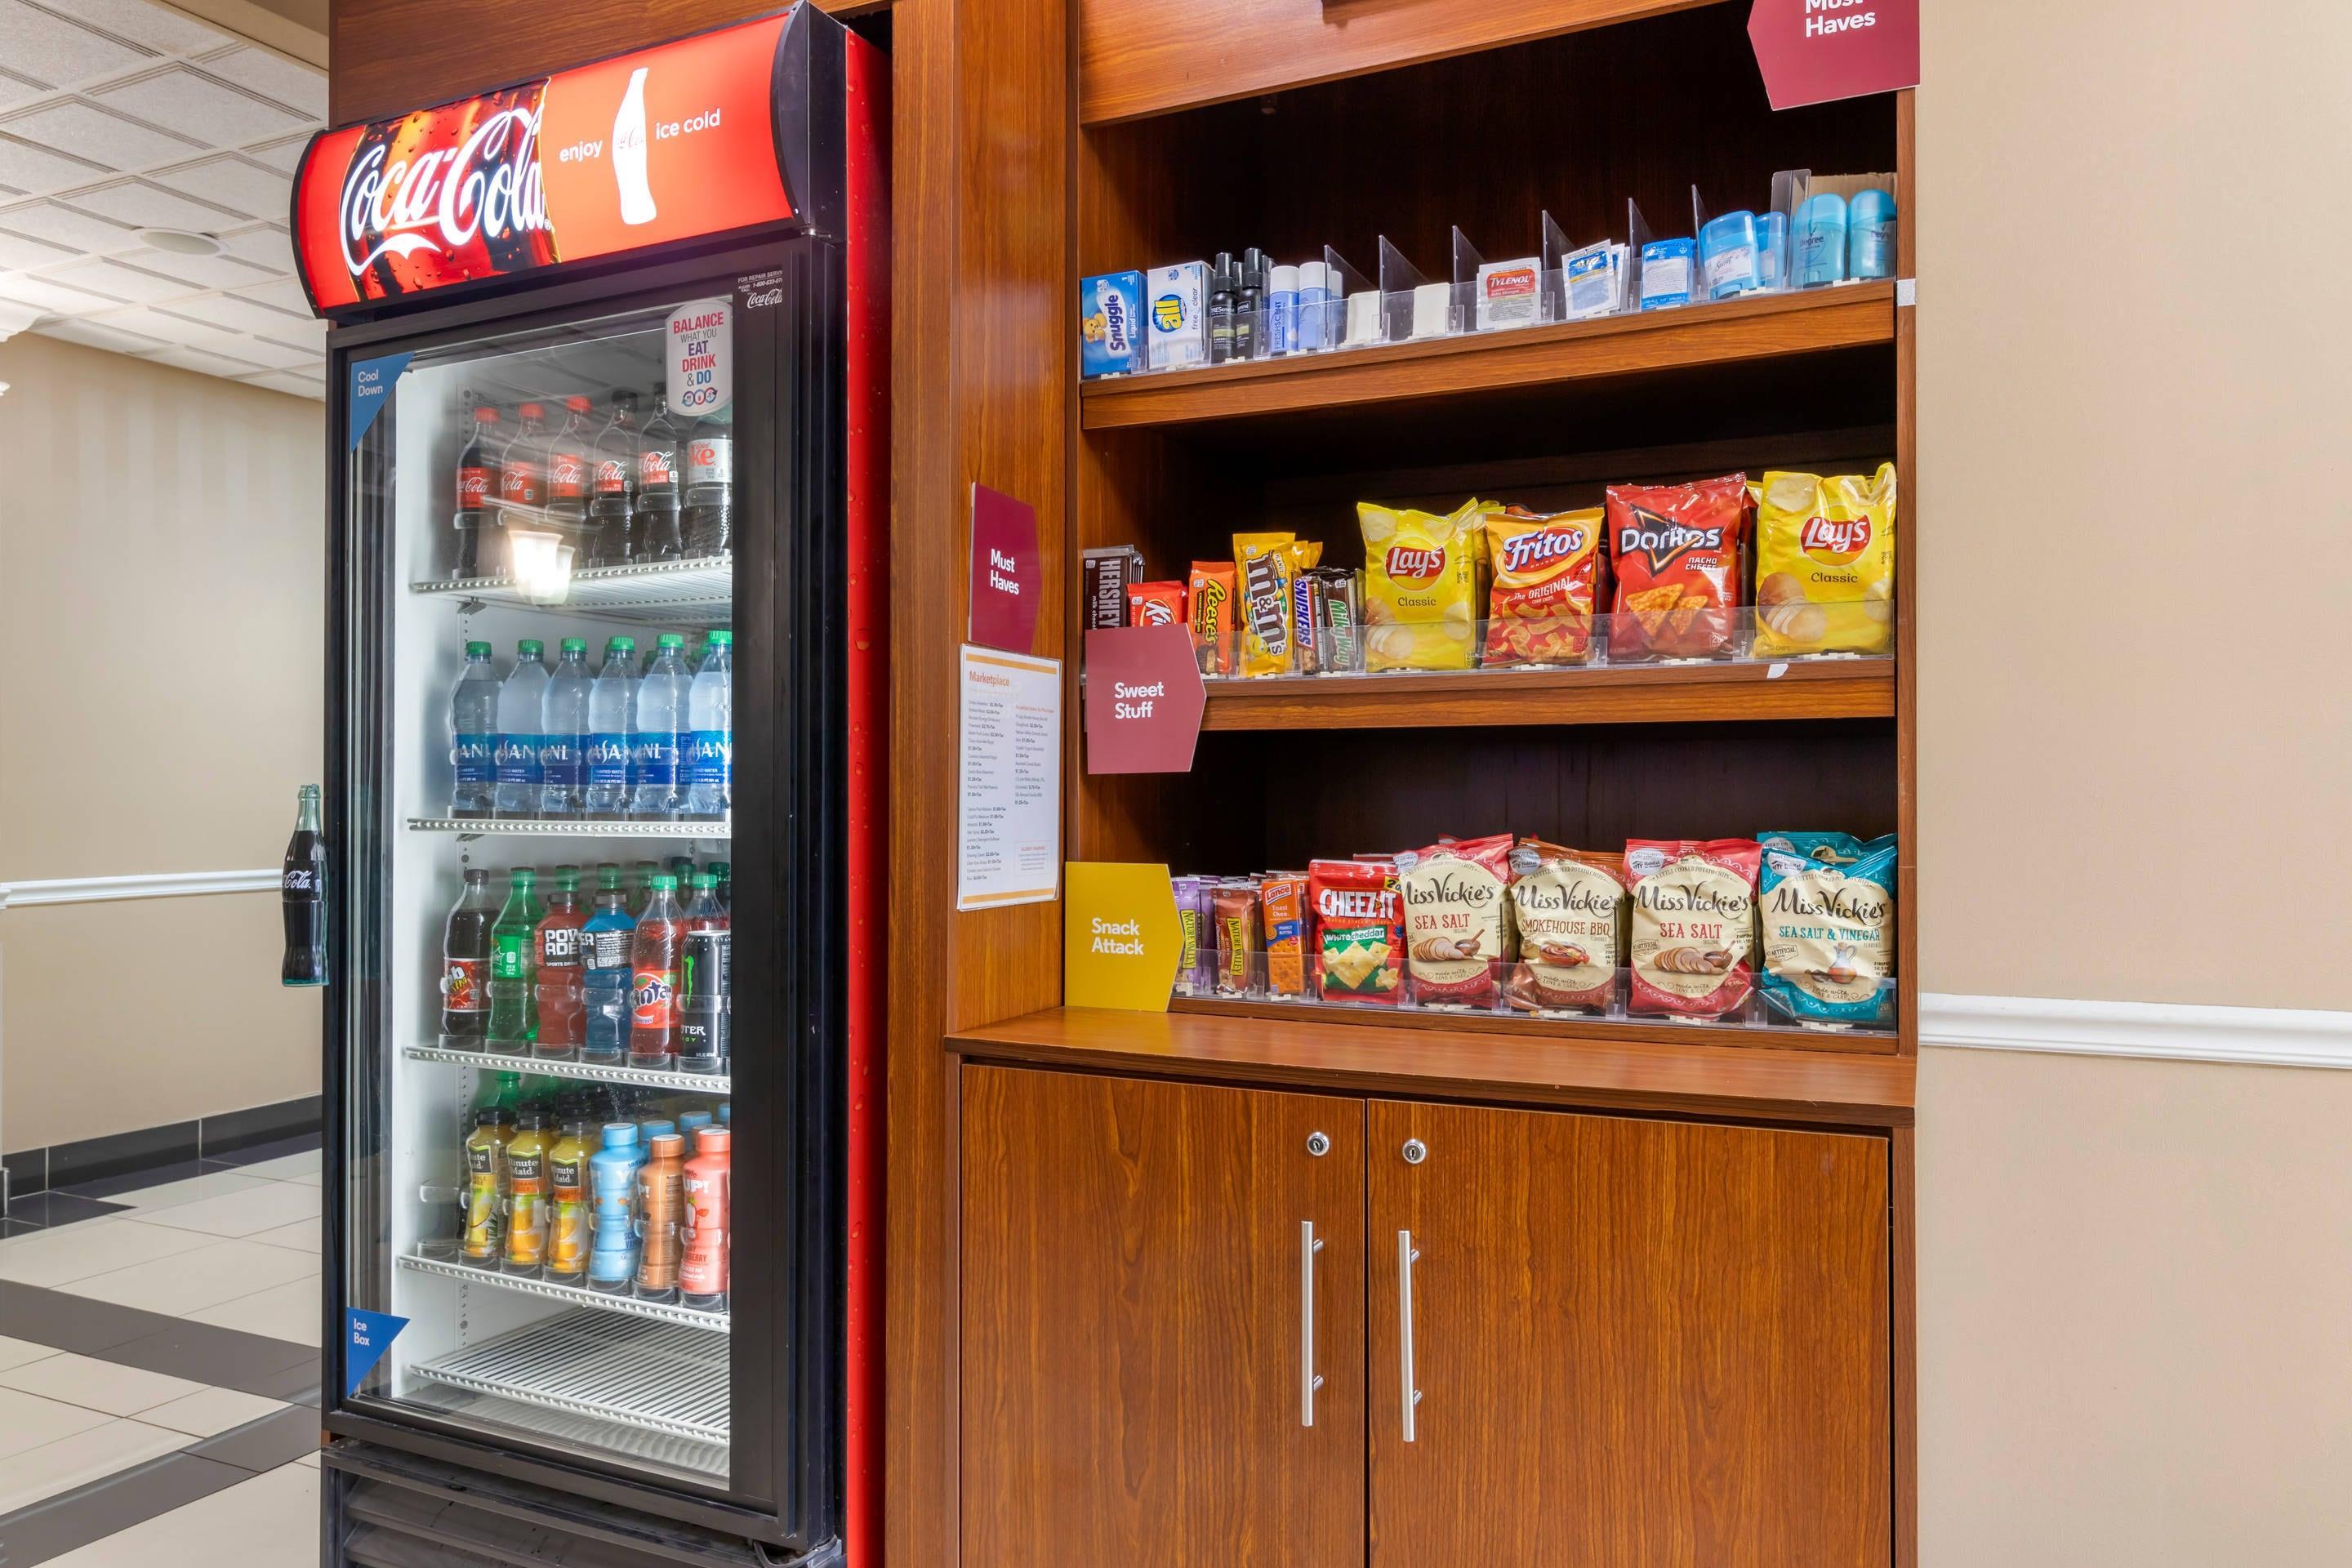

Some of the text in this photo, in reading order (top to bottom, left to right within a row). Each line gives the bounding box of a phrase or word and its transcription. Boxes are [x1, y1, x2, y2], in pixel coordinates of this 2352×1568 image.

[1806, 11, 1876, 38] Haves
[559, 138, 603, 163] enjoy
[656, 121, 679, 140] ice
[683, 108, 721, 131] cold
[340, 105, 550, 276] Coca-Cola
[1490, 275, 1530, 287] TYLENOL
[673, 312, 724, 334] BALANCE
[1104, 295, 1126, 351] Snuggle
[1155, 300, 1183, 329] all
[680, 328, 717, 343] WHAT YOU
[682, 354, 716, 372] DRINK
[358, 368, 379, 383] Cool
[687, 369, 711, 386] & DO
[358, 385, 383, 397] Down
[1621, 524, 1722, 554] Doritos
[1805, 518, 1868, 554] Lay's
[991, 548, 1015, 573] Must
[1503, 530, 1584, 572] Fritos
[990, 570, 1019, 595] Haves
[1811, 572, 1859, 584] Classic
[1099, 560, 1121, 627] HERSHEY
[1513, 576, 1573, 600] The ORIGINAL
[1205, 579, 1227, 644] Reese's
[1294, 578, 1312, 646] SNICKERS
[1398, 597, 1437, 608] Classic
[969, 670, 1009, 687] Marketplace
[1114, 681, 1164, 699] Sweet
[1114, 702, 1153, 719] Stuff
[1267, 887, 1290, 898] Lance
[1428, 872, 1494, 908] Vickie's
[1516, 885, 1560, 910] Miss
[1635, 880, 1748, 920] Miss Vickie's
[1771, 888, 1885, 926] Miss Vickie's
[1091, 917, 1140, 936] Snack
[1414, 914, 1470, 929] SEA SALT
[1521, 919, 1611, 938] SMOKEHOUSE BBQ
[1659, 923, 1722, 939] SEA SALT
[1183, 911, 1196, 967] NATURE VALLEY
[1352, 929, 1384, 940] cheddar
[1780, 926, 1880, 941] SEA SALT & VINEGAR
[545, 942, 578, 955] ADE
[1091, 937, 1144, 956] Attack
[1228, 920, 1242, 973] NATURE VALLEY
[1771, 947, 1796, 956] ARTIFICIAL
[684, 1178, 710, 1193] UP!
[354, 1318, 367, 1331] Ice
[354, 1332, 370, 1346] Box
